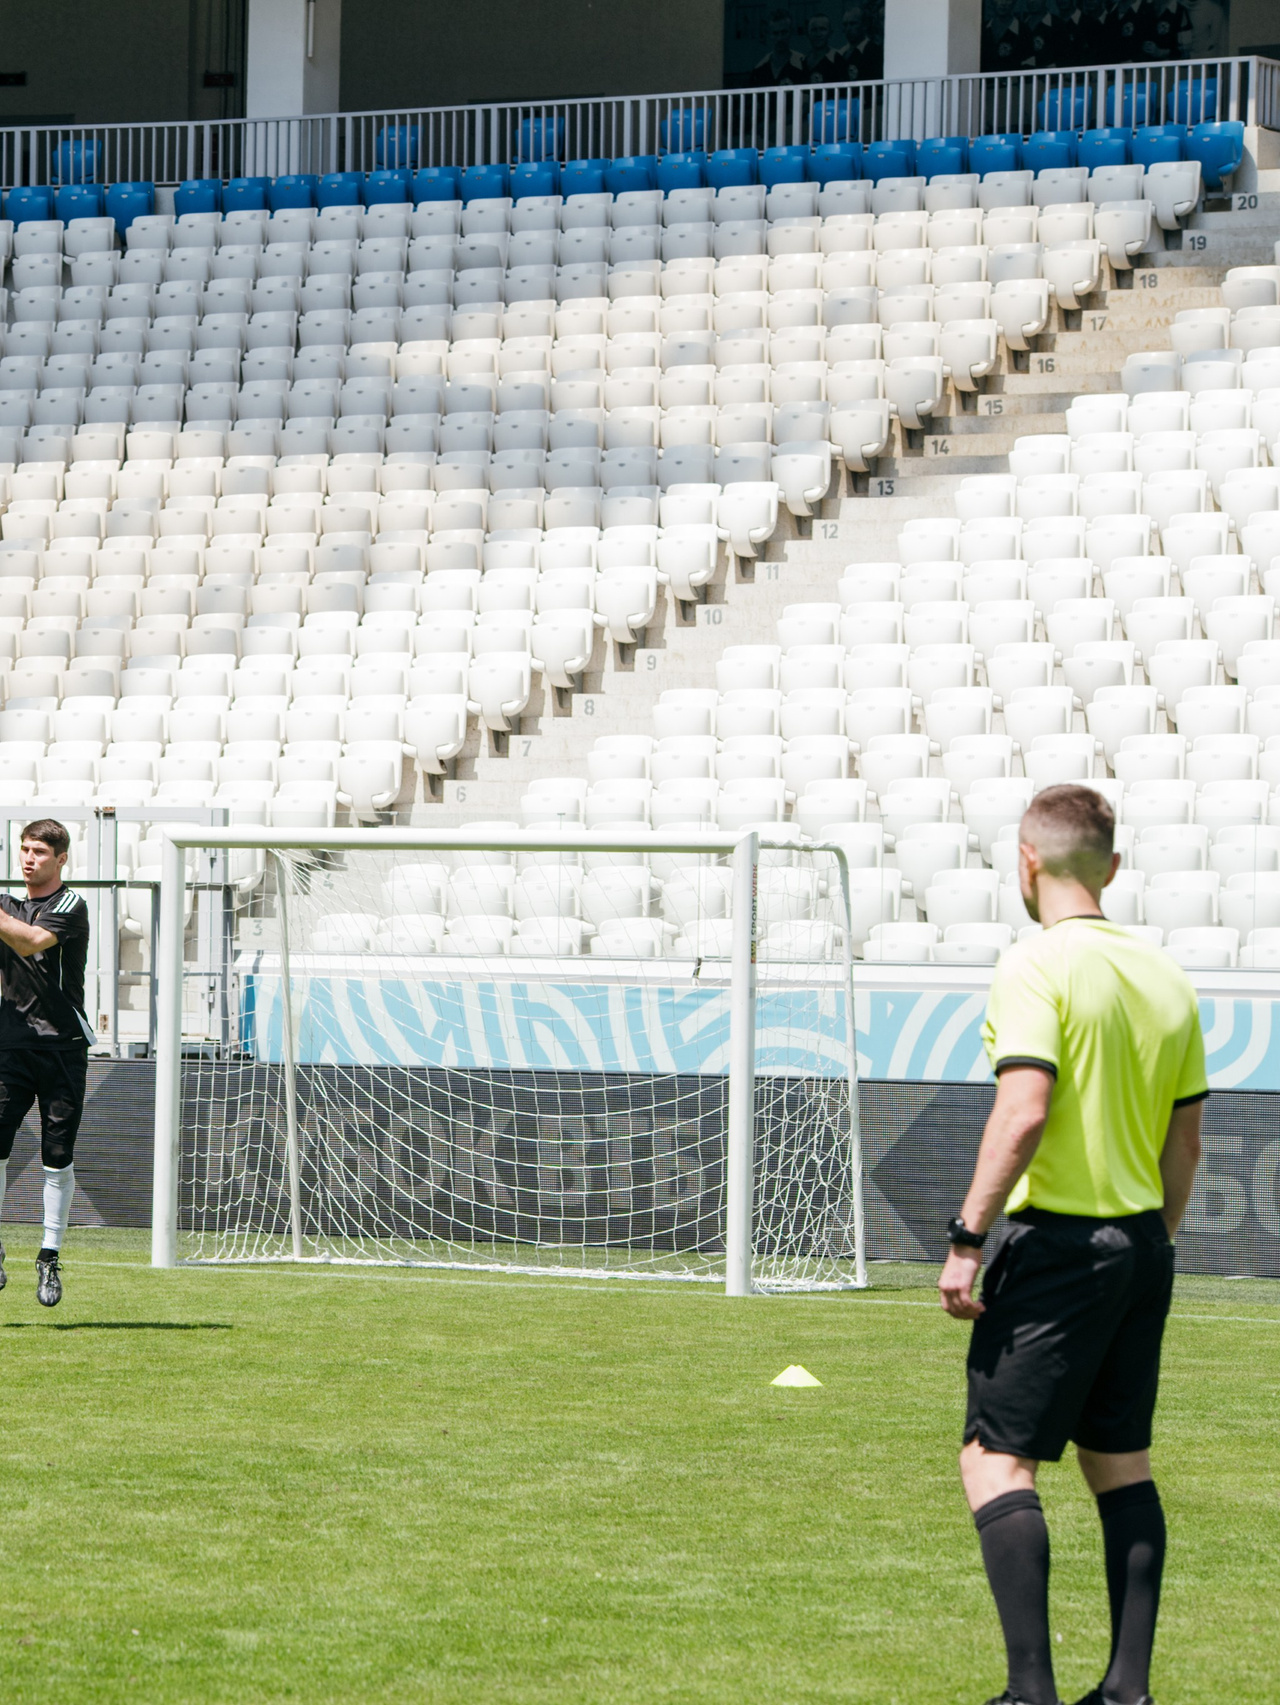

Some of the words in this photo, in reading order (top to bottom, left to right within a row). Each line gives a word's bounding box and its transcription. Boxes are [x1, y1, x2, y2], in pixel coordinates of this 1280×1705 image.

[1237, 194, 1259, 211] 20
[1189, 235, 1207, 251] 19
[1139, 273, 1158, 288] 18
[1090, 316, 1107, 331] 17
[1037, 358, 1056, 374] 16
[985, 399, 1003, 415] 15
[931, 439, 950, 454] 14
[877, 479, 895, 496] 13
[821, 523, 839, 539] 12
[765, 563, 780, 580] 11
[704, 609, 723, 625] 10
[646, 654, 657, 671] 9
[584, 699, 595, 716] 8
[522, 740, 533, 757] 7
[456, 786, 467, 803] 6
[253, 919, 263, 936] 3
